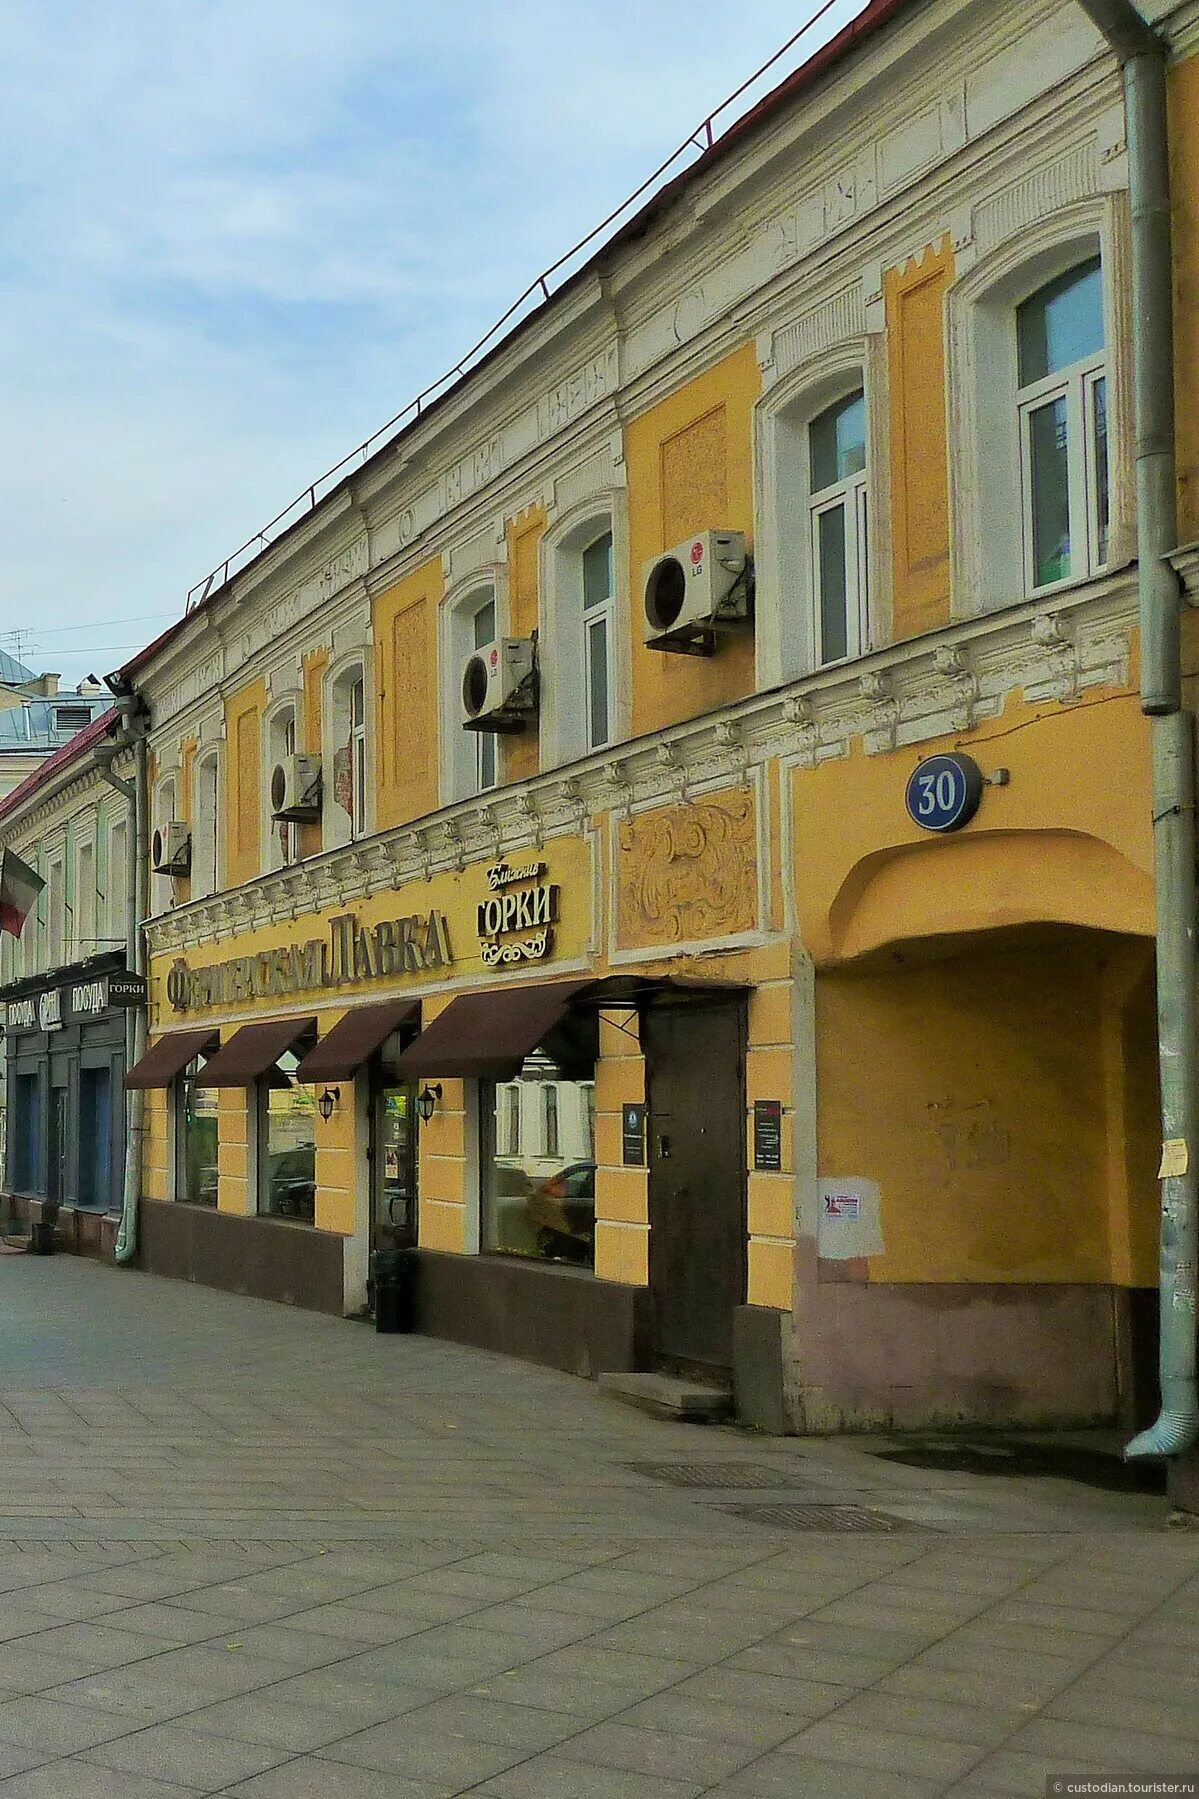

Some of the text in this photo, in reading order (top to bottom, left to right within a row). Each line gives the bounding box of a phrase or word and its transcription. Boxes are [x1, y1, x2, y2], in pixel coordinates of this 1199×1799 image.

[691, 565, 703, 577] LG
[918, 770, 956, 815] 30
[476, 884, 554, 937] ГОРКИ
[72, 981, 105, 1014] ПОСУДА
[109, 984, 145, 994] ГОРКИ
